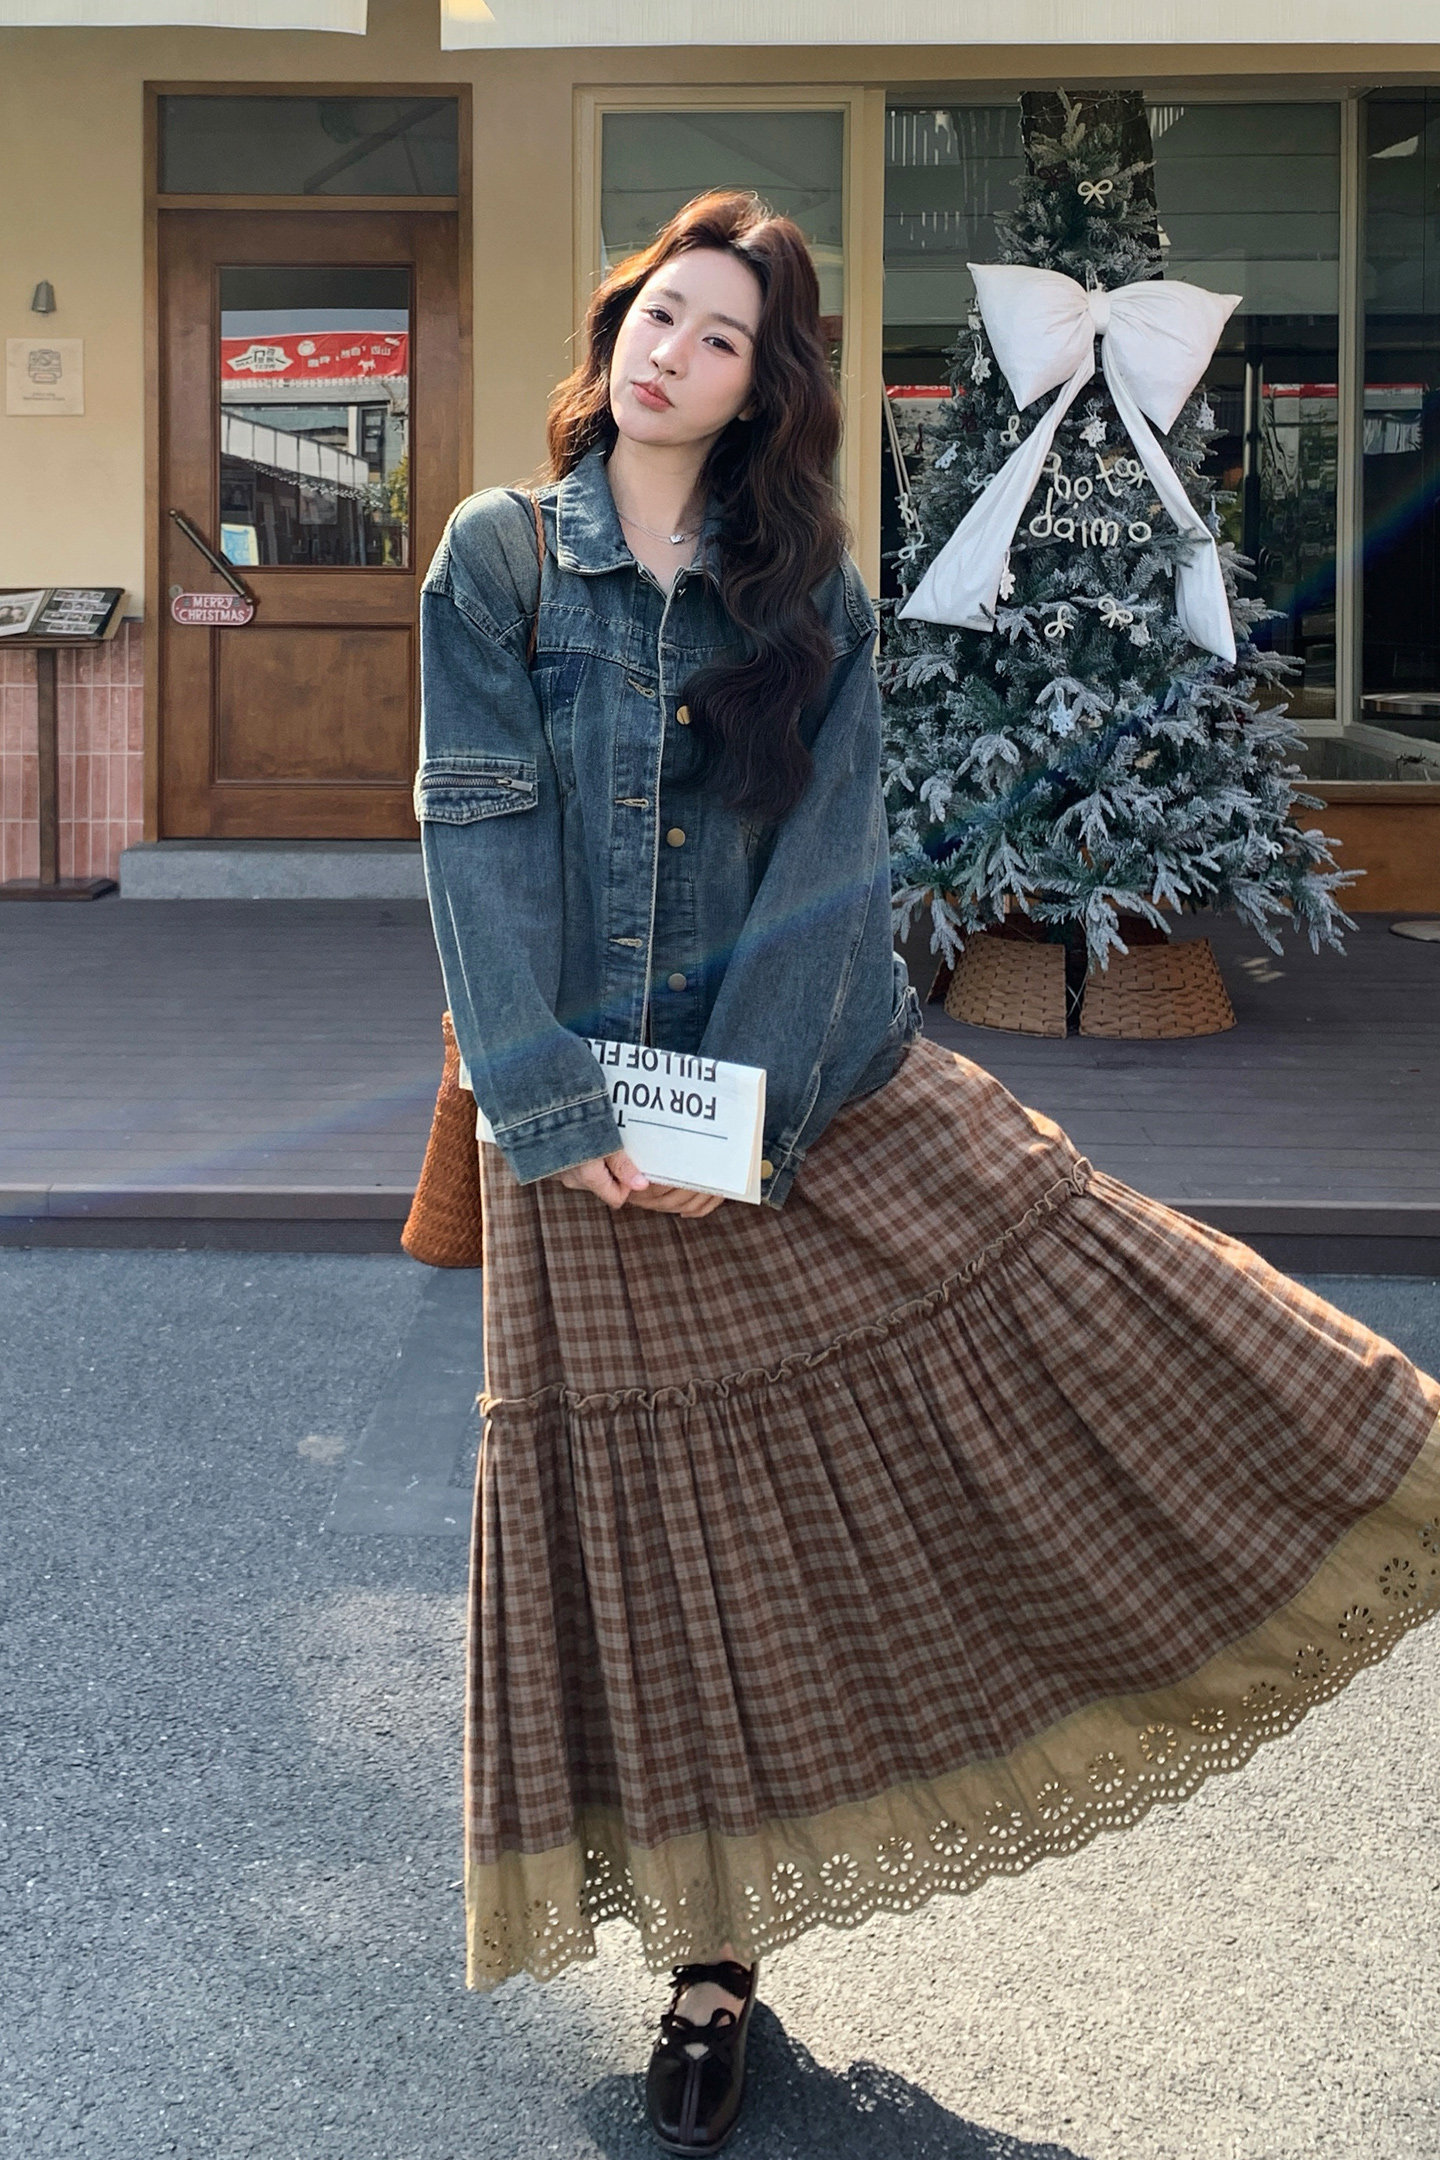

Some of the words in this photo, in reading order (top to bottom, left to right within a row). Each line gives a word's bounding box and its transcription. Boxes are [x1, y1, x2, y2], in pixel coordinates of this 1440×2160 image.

[192, 596, 234, 609] MERRY
[178, 609, 246, 622] CHRISTMAS
[612, 1080, 665, 1111] YOU
[669, 1088, 717, 1121] FOR
